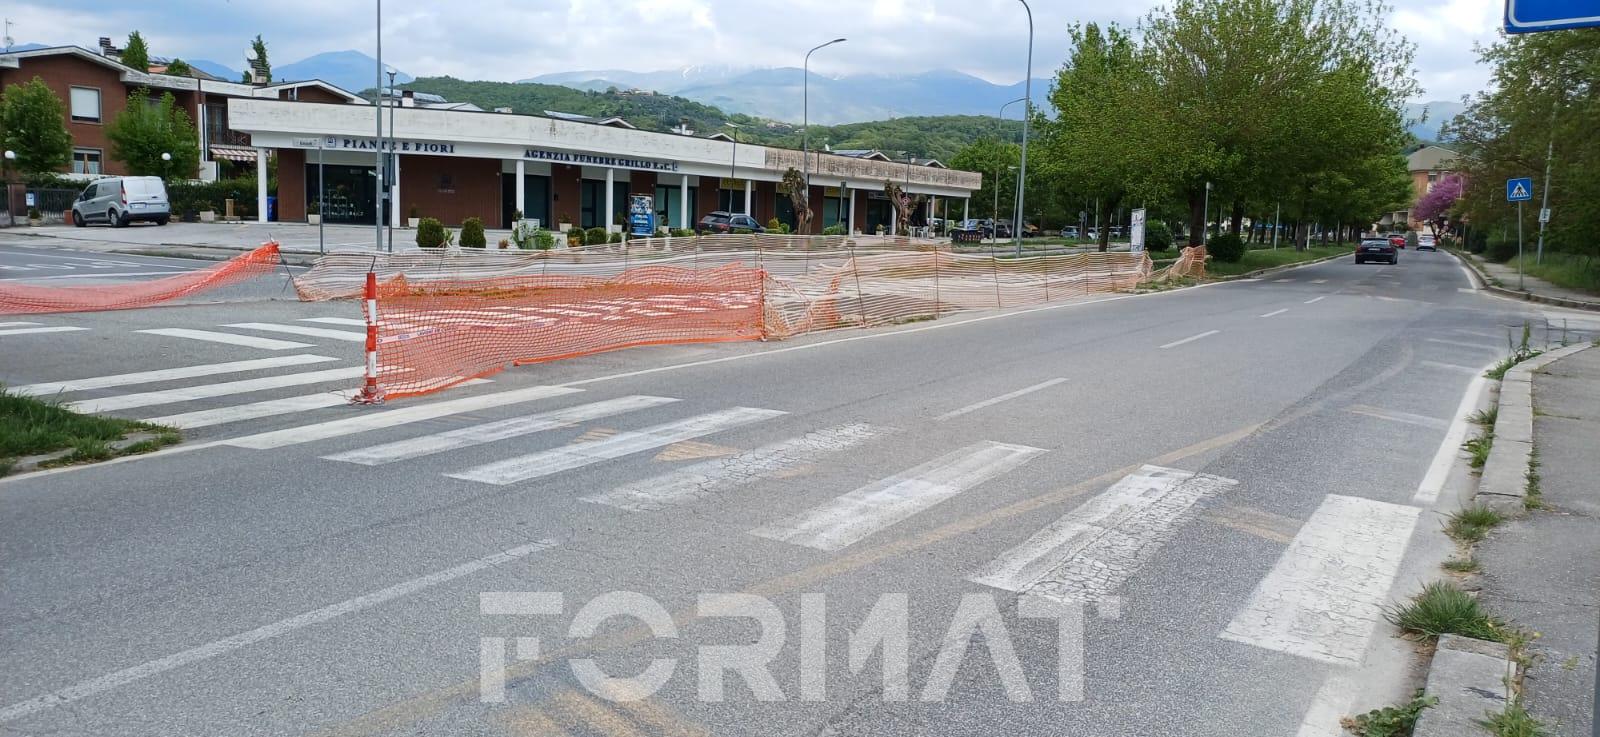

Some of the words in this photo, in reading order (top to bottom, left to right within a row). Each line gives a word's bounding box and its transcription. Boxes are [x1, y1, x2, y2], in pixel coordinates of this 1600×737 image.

[343, 139, 396, 150] PIANTE
[402, 142, 409, 151] E
[415, 142, 455, 153] FIORI
[524, 149, 570, 161] AGENZIA
[573, 154, 616, 166] FUNEBRE
[618, 158, 651, 169] GRILLO
